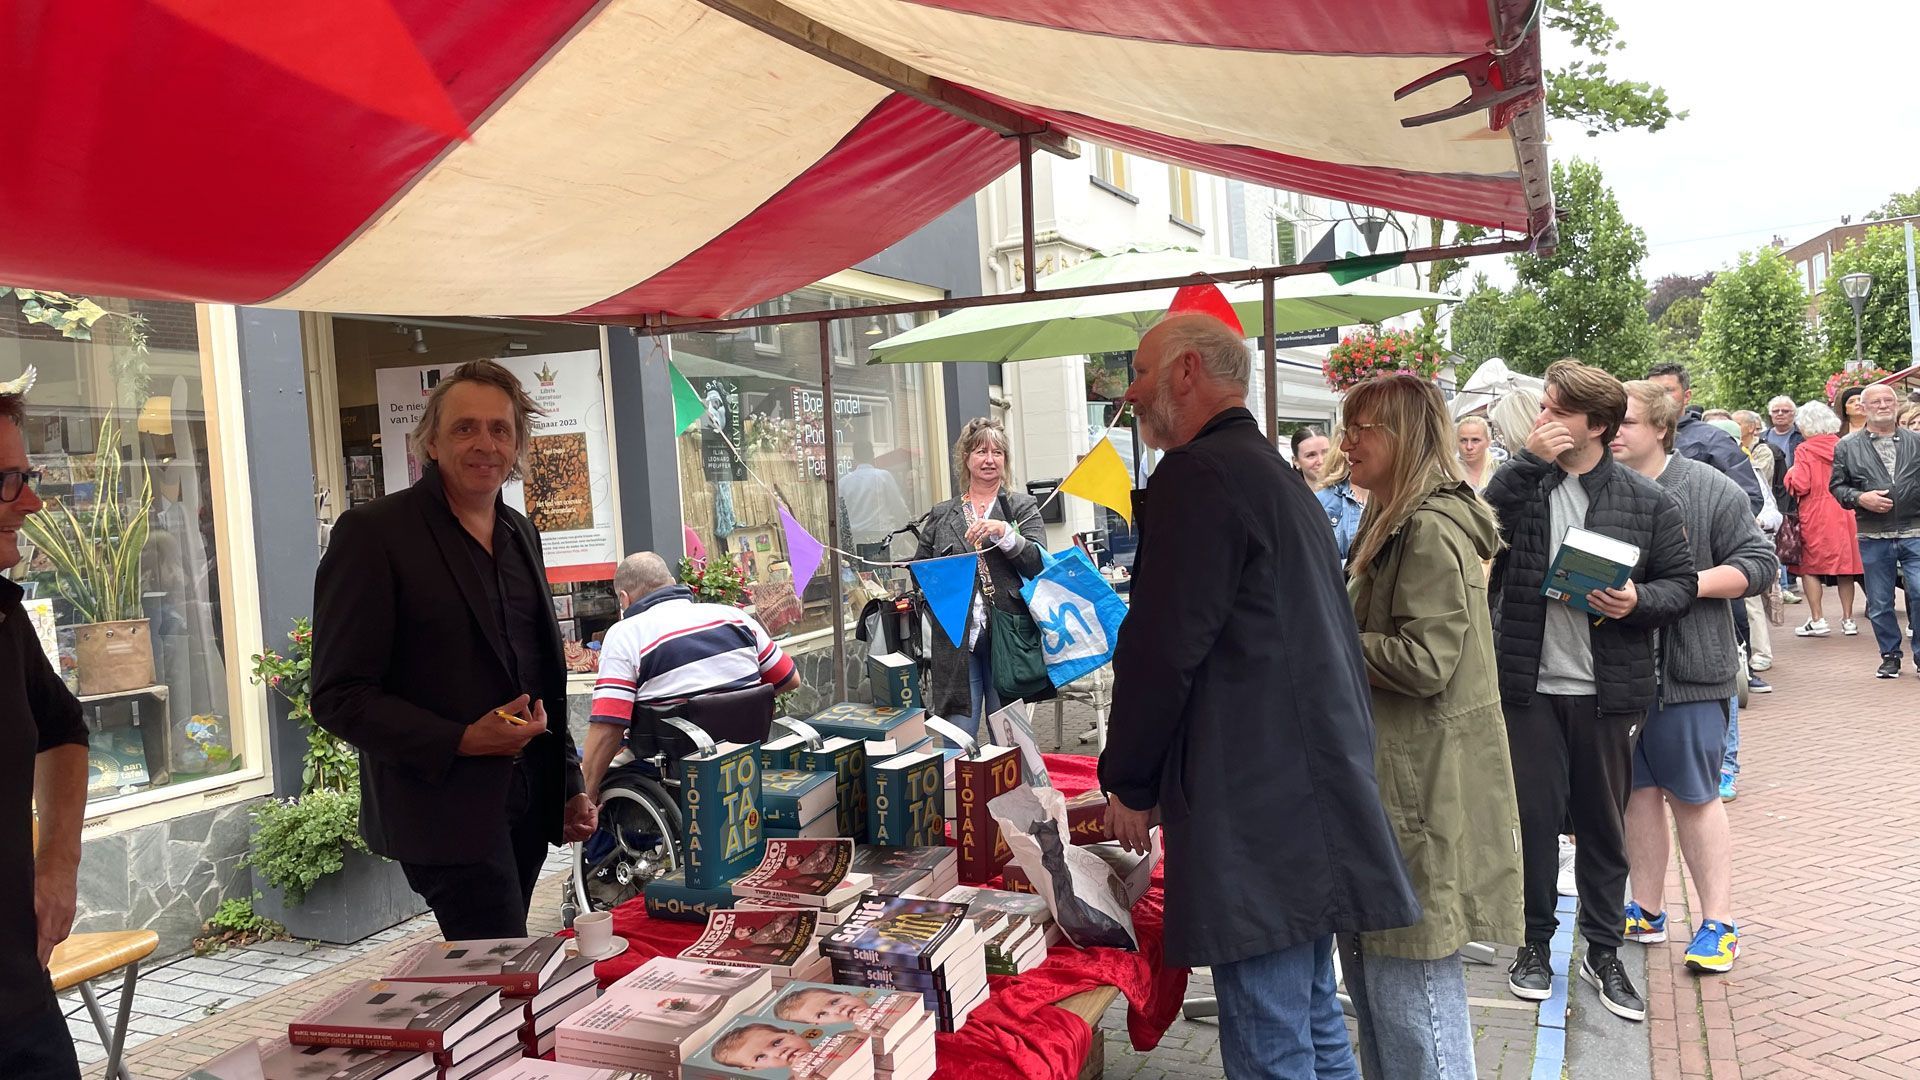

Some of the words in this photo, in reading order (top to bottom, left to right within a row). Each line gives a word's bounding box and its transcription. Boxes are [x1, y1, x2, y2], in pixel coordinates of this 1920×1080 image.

[390, 403, 403, 412] De
[406, 403, 427, 411] nieu
[390, 416, 408, 424] van
[123, 763, 142, 771] aan
[720, 755, 756, 793] TO
[907, 765, 940, 799] TO
[687, 773, 702, 867] TOTAAL
[961, 773, 976, 862] TOTAAL
[772, 891, 800, 899] JANSSEN
[831, 900, 886, 944] Schijt
[853, 949, 880, 962] Schijt
[867, 969, 894, 983] Schijt
